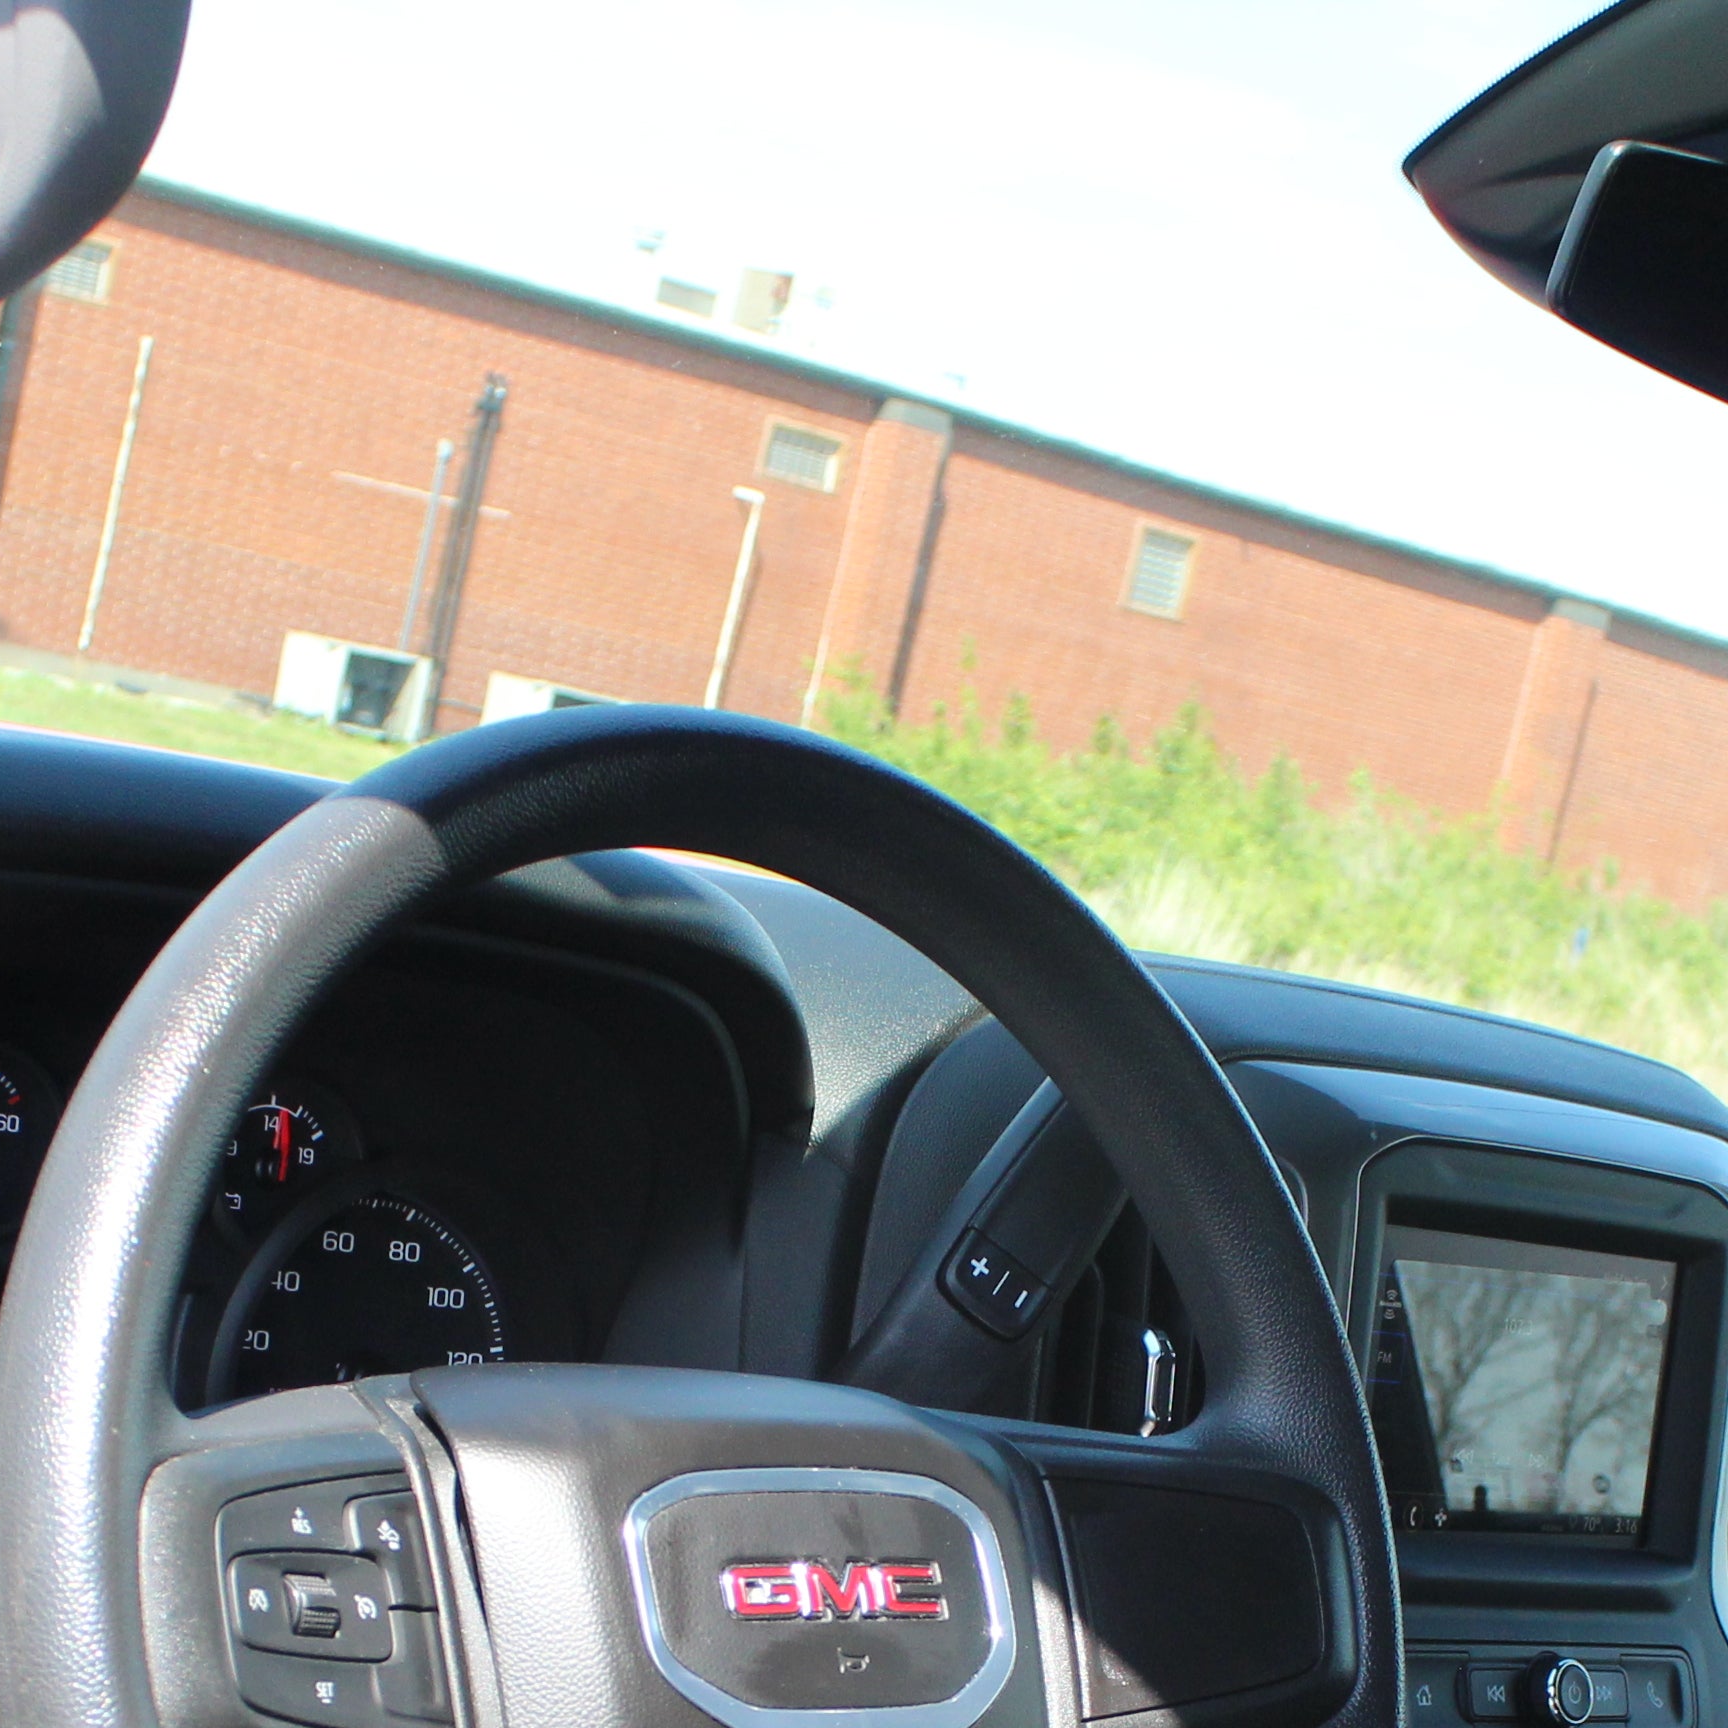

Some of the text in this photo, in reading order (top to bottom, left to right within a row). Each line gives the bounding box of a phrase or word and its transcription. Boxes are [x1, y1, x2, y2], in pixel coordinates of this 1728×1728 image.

[297, 1146, 315, 1165] 19
[322, 1230, 355, 1253] 60
[388, 1240, 421, 1263] 80
[426, 1286, 466, 1309] 100
[1376, 1351, 1393, 1364] FM
[719, 1557, 950, 1622] GMC
[314, 1681, 335, 1698] SET
